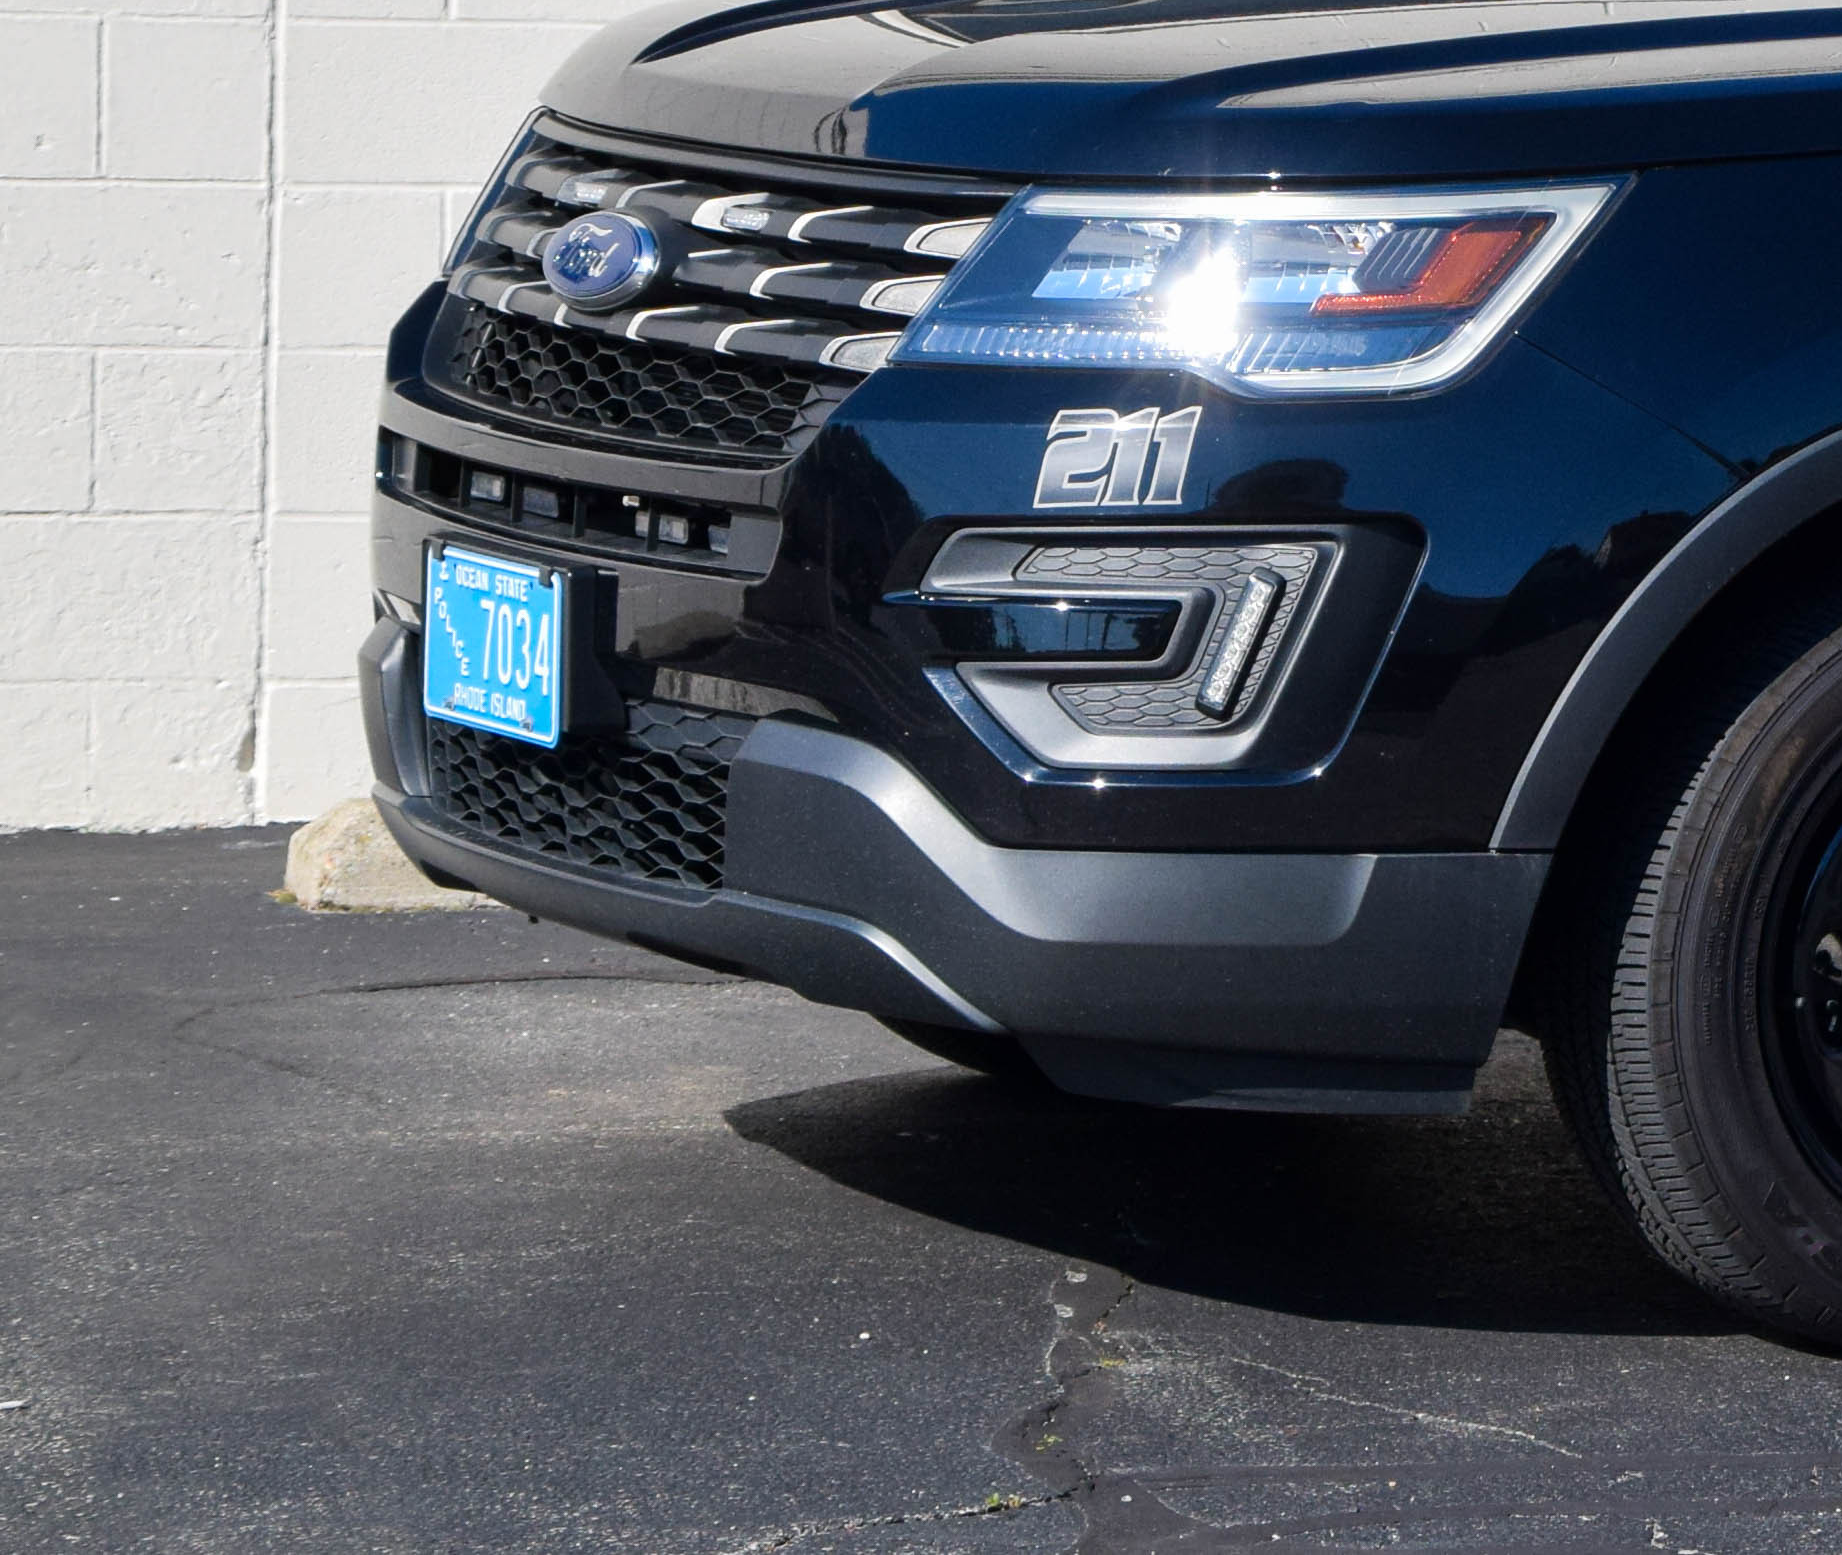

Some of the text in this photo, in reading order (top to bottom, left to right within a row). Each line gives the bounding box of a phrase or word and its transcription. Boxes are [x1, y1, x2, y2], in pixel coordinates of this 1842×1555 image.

[552, 223, 620, 278] Ford
[1032, 405, 1203, 509] 211
[455, 563, 529, 603] OCEAN STATE
[433, 586, 471, 677] POLICE
[480, 598, 550, 697] 7034
[453, 682, 526, 721] RHODE ISLAND
